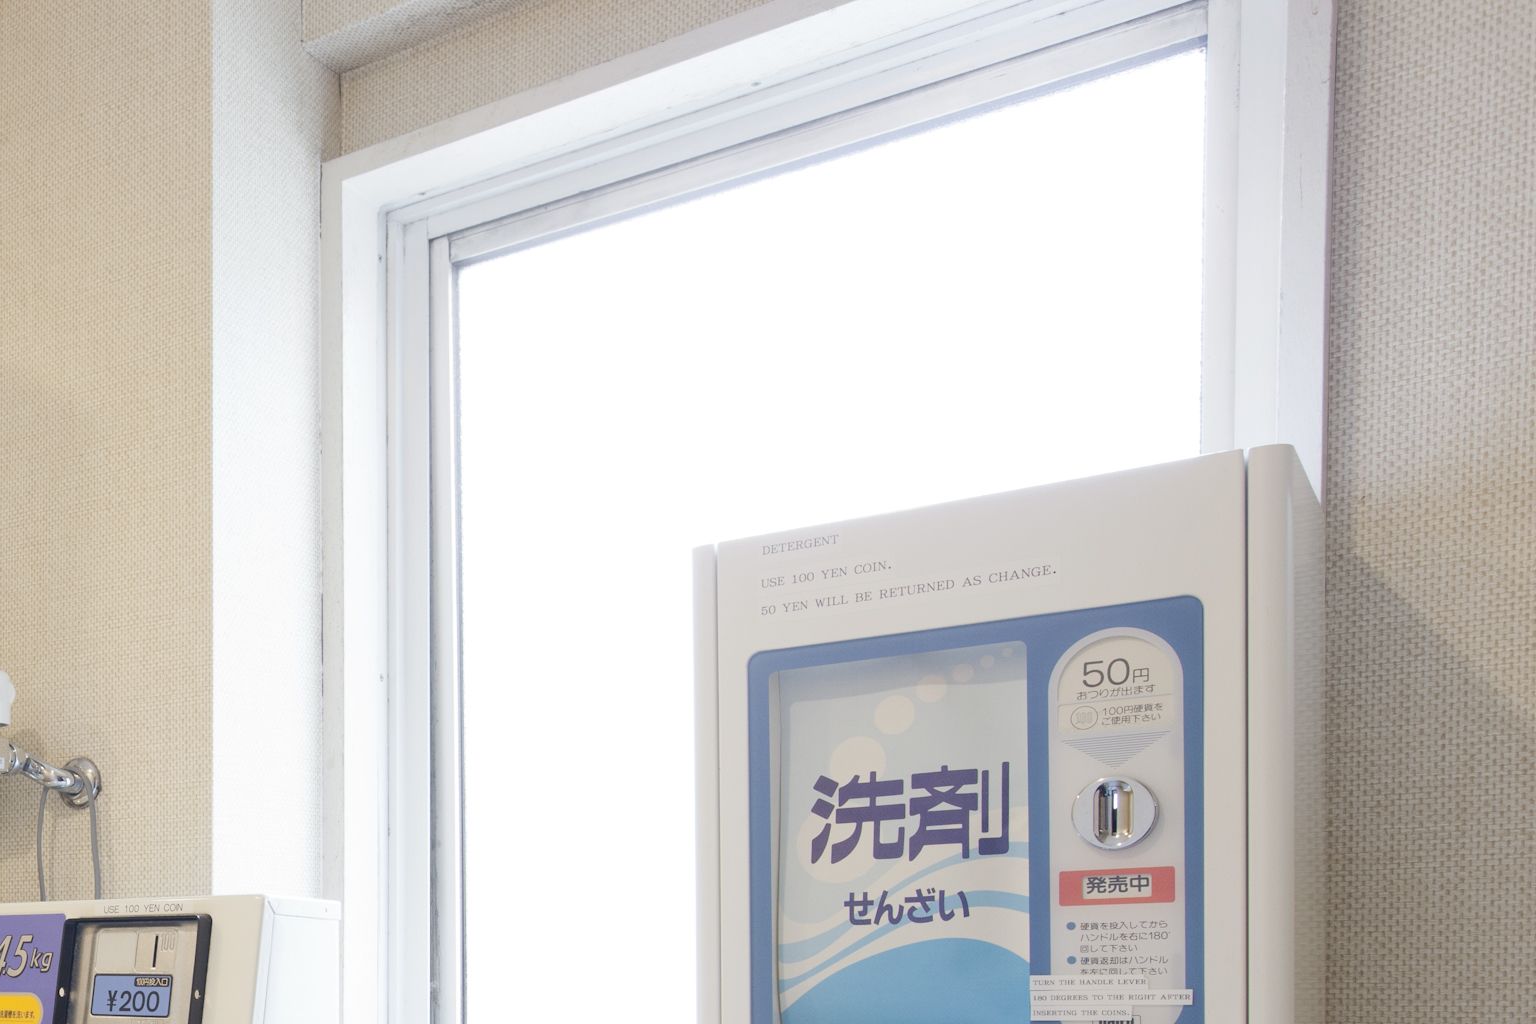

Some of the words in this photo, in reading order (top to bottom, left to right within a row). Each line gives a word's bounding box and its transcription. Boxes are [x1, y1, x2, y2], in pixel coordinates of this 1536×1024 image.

[762, 534, 839, 556] DETERGENT
[761, 576, 785, 589] USE
[792, 571, 815, 585] 100
[821, 567, 848, 580] YEN
[854, 560, 892, 575] COIN.
[761, 605, 776, 616] 50
[783, 600, 809, 614] YEN
[815, 595, 849, 609] WILL
[855, 591, 873, 604] BE
[880, 579, 955, 601] RETURNED
[962, 574, 982, 588] AS
[989, 564, 1057, 585] CHANGE.
[1082, 657, 1150, 688] 50円
[1076, 684, 1156, 701] おつりが出ます
[1102, 703, 1163, 716] 100円硬貨を
[1102, 713, 1161, 726] ご使用下さい
[810, 761, 1010, 864] 洗剤
[1086, 874, 1150, 895] 発売中
[103, 905, 120, 914] USE
[125, 904, 140, 913] 100
[144, 904, 160, 912] YEN
[164, 903, 184, 912] COIN
[843, 887, 970, 926] せんざい
[1080, 920, 1168, 931] 硬貨を投入してから
[1080, 944, 1138, 954] 回して下さい
[1080, 955, 1168, 966] 硬貨返却はハンドル
[107, 990, 160, 1013] ¥200
